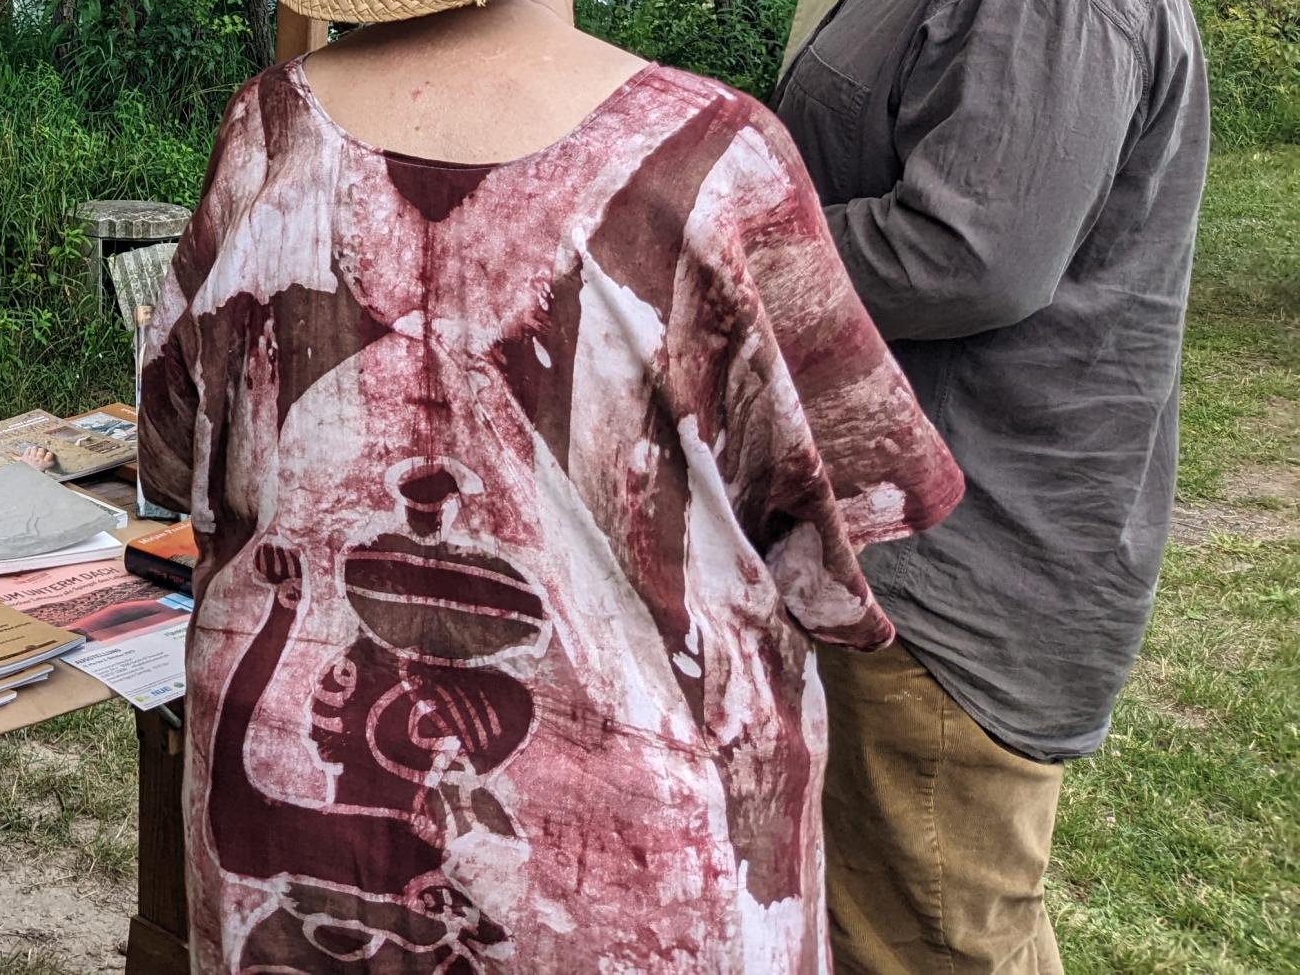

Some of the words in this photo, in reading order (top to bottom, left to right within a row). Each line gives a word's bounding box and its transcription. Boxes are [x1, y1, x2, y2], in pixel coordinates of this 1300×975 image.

[24, 577, 79, 596] UNTERM
[79, 566, 118, 583] DACH
[74, 647, 122, 665] AUSSTELLUNG
[150, 686, 172, 698] NUE
